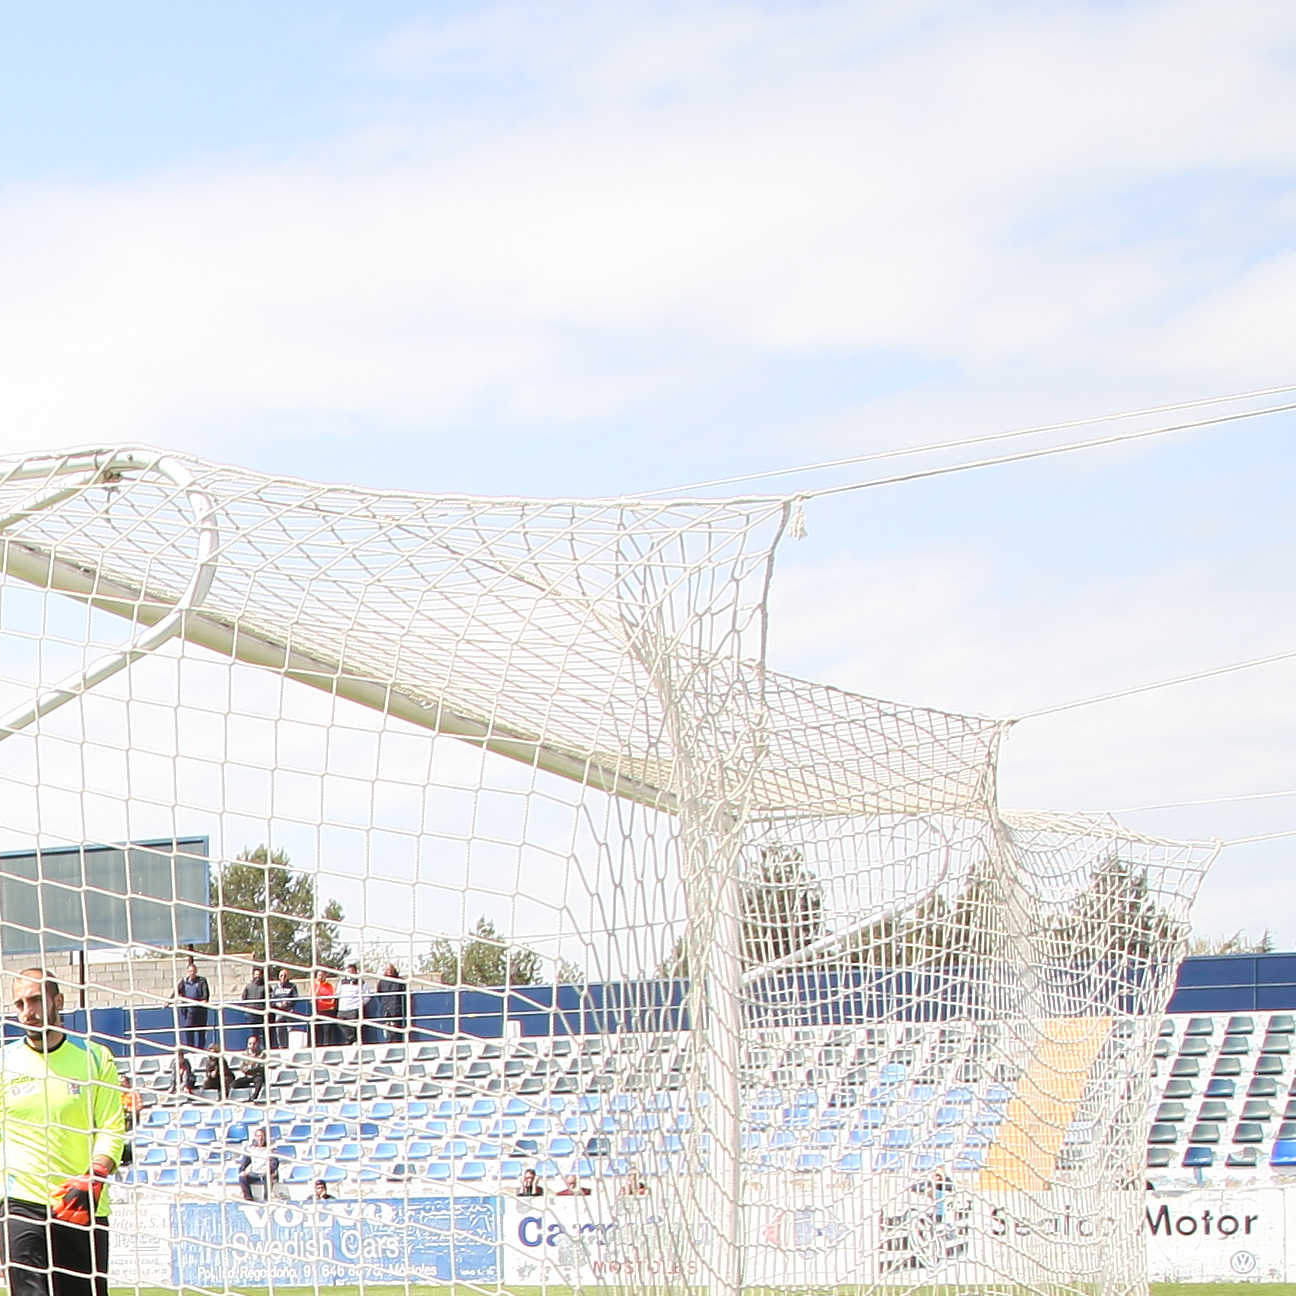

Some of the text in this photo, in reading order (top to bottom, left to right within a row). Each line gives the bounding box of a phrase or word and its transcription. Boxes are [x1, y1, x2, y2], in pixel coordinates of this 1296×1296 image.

[239, 1202, 395, 1229] VOLVO
[1144, 1204, 1258, 1237] Motor
[231, 1231, 338, 1262] Swedish
